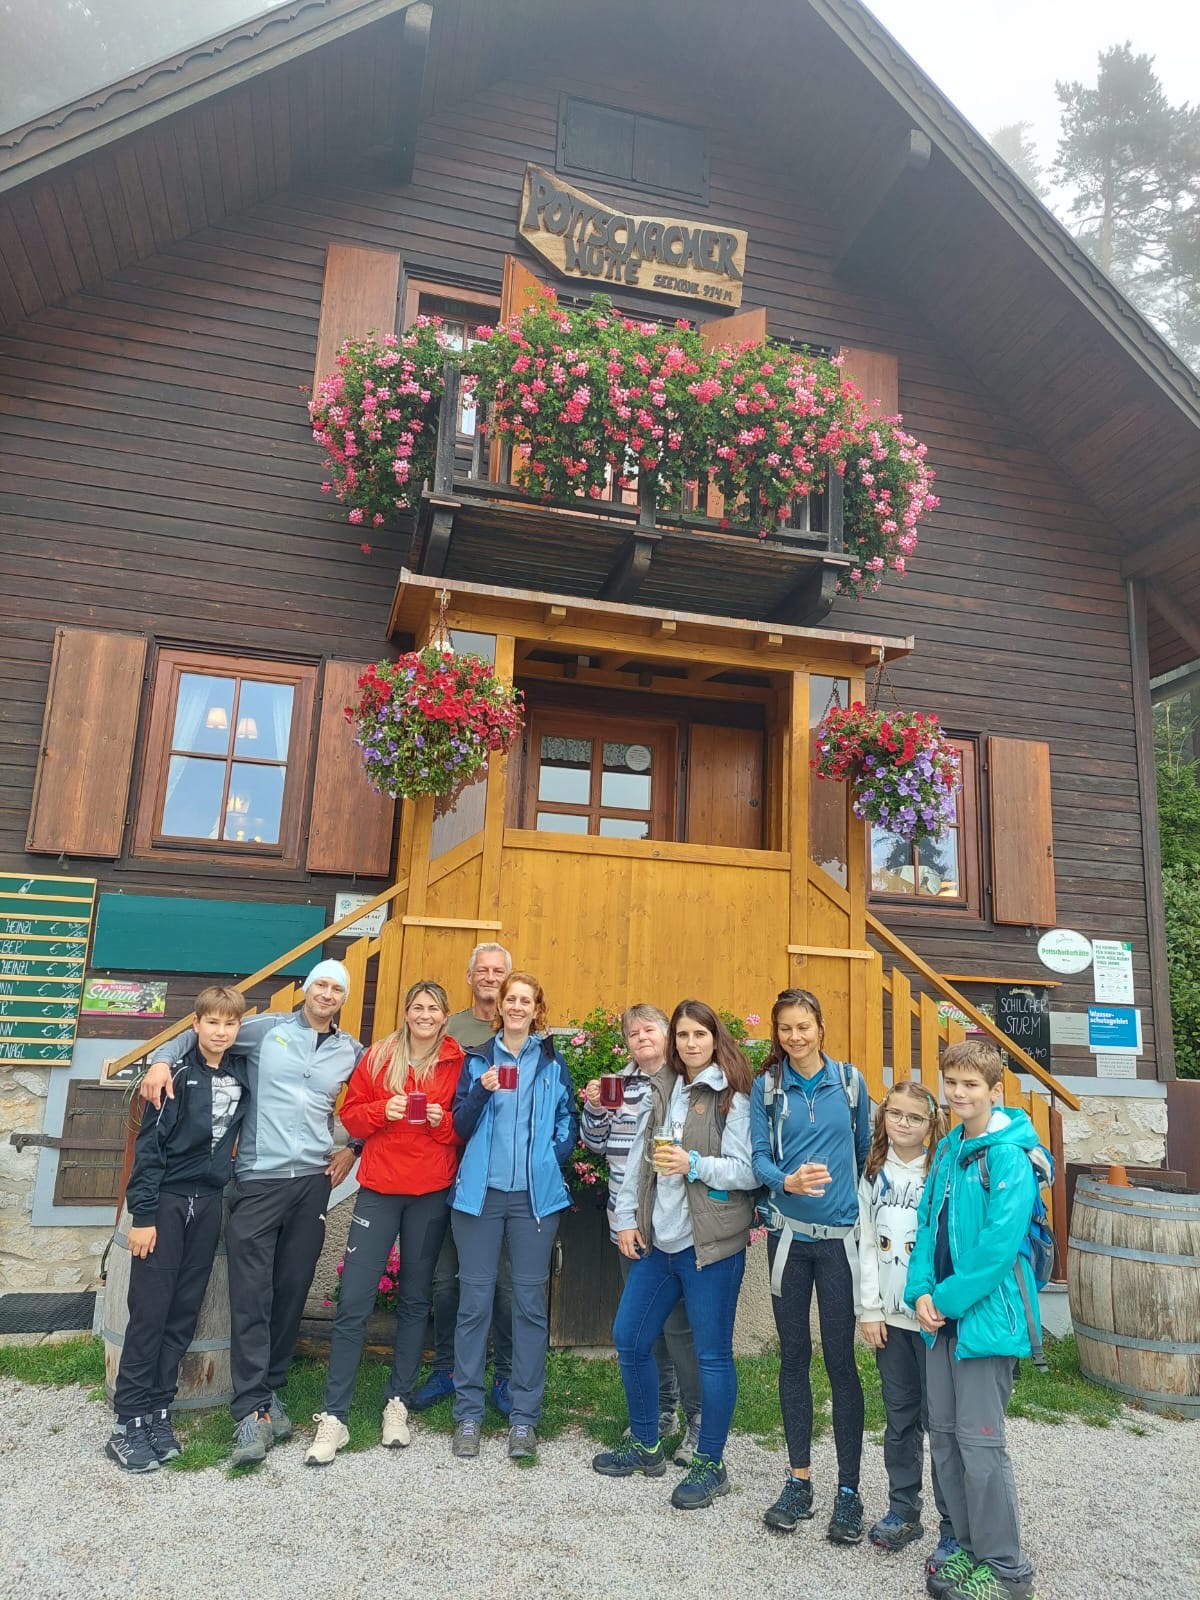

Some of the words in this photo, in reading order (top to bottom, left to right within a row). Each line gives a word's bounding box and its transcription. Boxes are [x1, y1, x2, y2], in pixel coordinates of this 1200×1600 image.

[523, 172, 742, 280] POTTSCHACHER
[86, 984, 142, 1002] Sturm
[1001, 998, 1048, 1013] SCHILCHER
[1089, 1010, 1115, 1018] Wasser-
[1005, 1016, 1041, 1038] STURM
